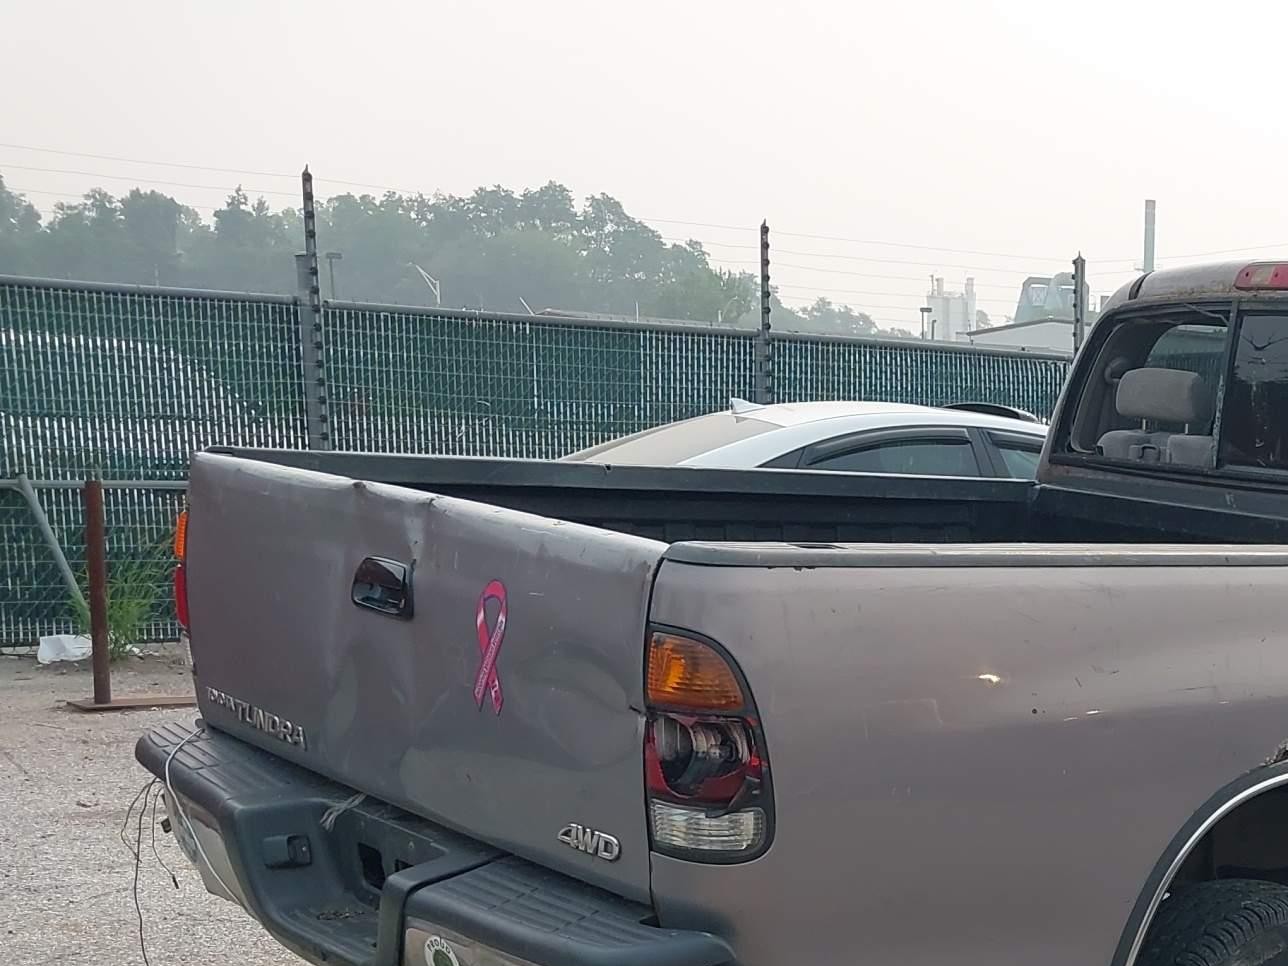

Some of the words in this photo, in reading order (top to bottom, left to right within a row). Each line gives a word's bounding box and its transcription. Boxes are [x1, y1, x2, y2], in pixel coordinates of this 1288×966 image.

[235, 698, 306, 749] TUNDRA
[557, 822, 621, 860] 4WD
[426, 938, 452, 954] PROUD
